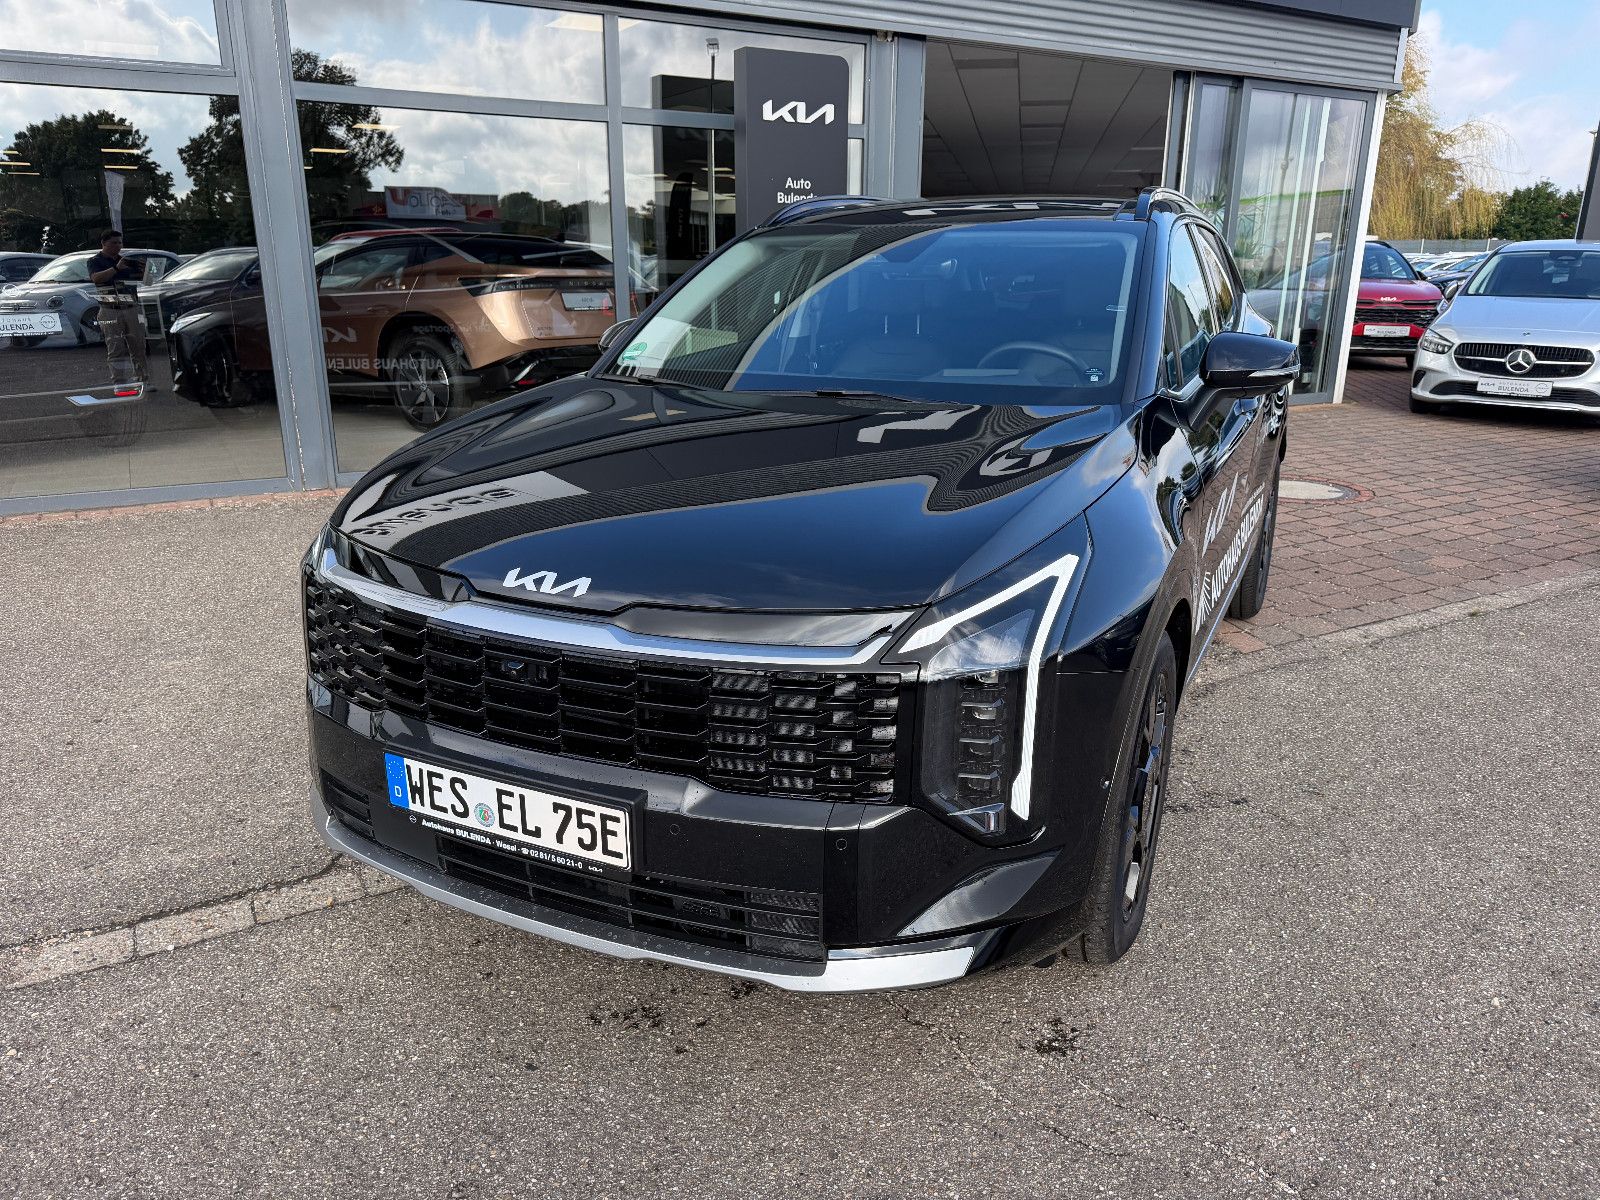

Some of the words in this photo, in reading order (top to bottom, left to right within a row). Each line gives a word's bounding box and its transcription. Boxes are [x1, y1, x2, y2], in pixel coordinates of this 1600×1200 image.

[762, 99, 835, 125] KIA
[785, 176, 812, 189] Auto
[502, 567, 592, 598] KIA
[405, 763, 470, 819] WES
[496, 787, 542, 839] EL
[552, 801, 624, 860] 75E
[421, 818, 455, 834] Autohaus
[455, 828, 491, 845] BULENDA
